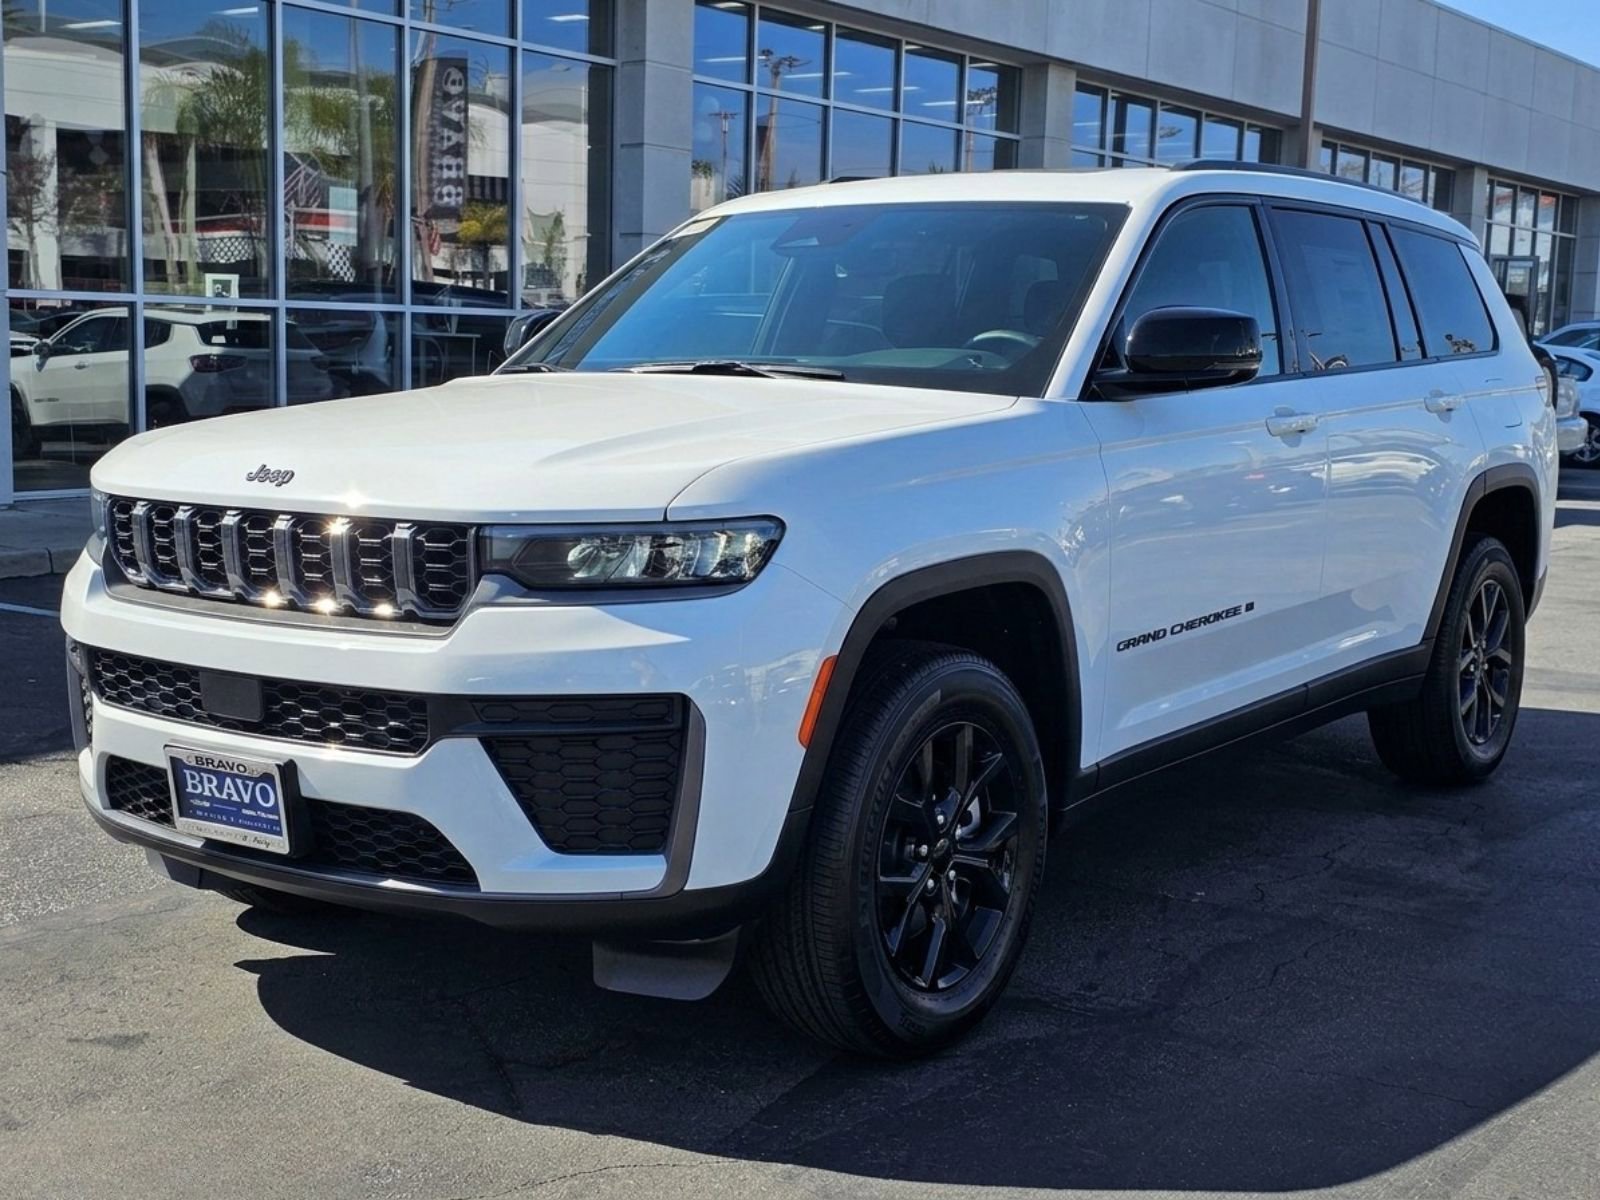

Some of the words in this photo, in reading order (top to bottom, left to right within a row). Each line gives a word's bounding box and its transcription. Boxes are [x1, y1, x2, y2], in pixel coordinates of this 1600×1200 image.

[246, 464, 295, 487] Jeep
[1116, 627, 1167, 652] GRAND
[1170, 604, 1242, 636] CHEROKEE
[194, 755, 248, 774] BRAVO
[183, 769, 276, 808] BRAVO
